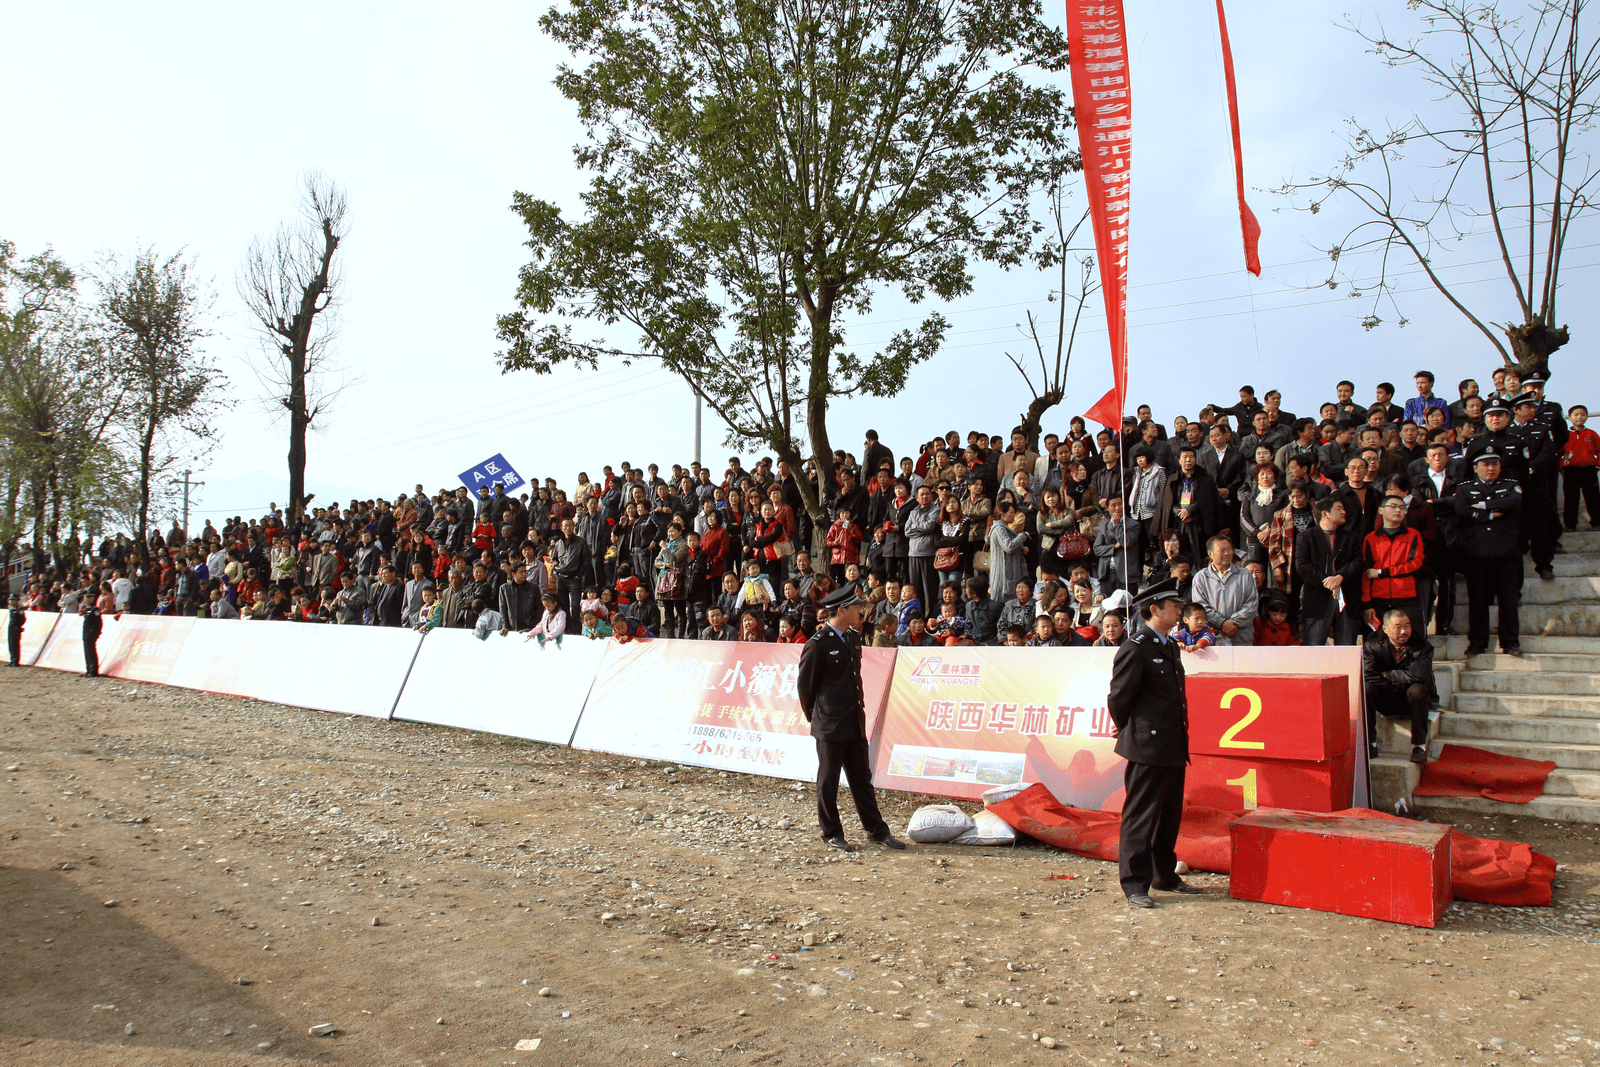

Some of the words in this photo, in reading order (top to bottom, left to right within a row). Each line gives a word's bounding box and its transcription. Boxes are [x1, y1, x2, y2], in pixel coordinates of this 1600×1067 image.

[473, 461, 502, 483] A区
[910, 677, 939, 685] HUALIN
[941, 678, 980, 686] KUANGYE
[926, 700, 1117, 739] 陕西华林矿业
[1219, 687, 1265, 750] 2
[1226, 769, 1257, 810] 1
